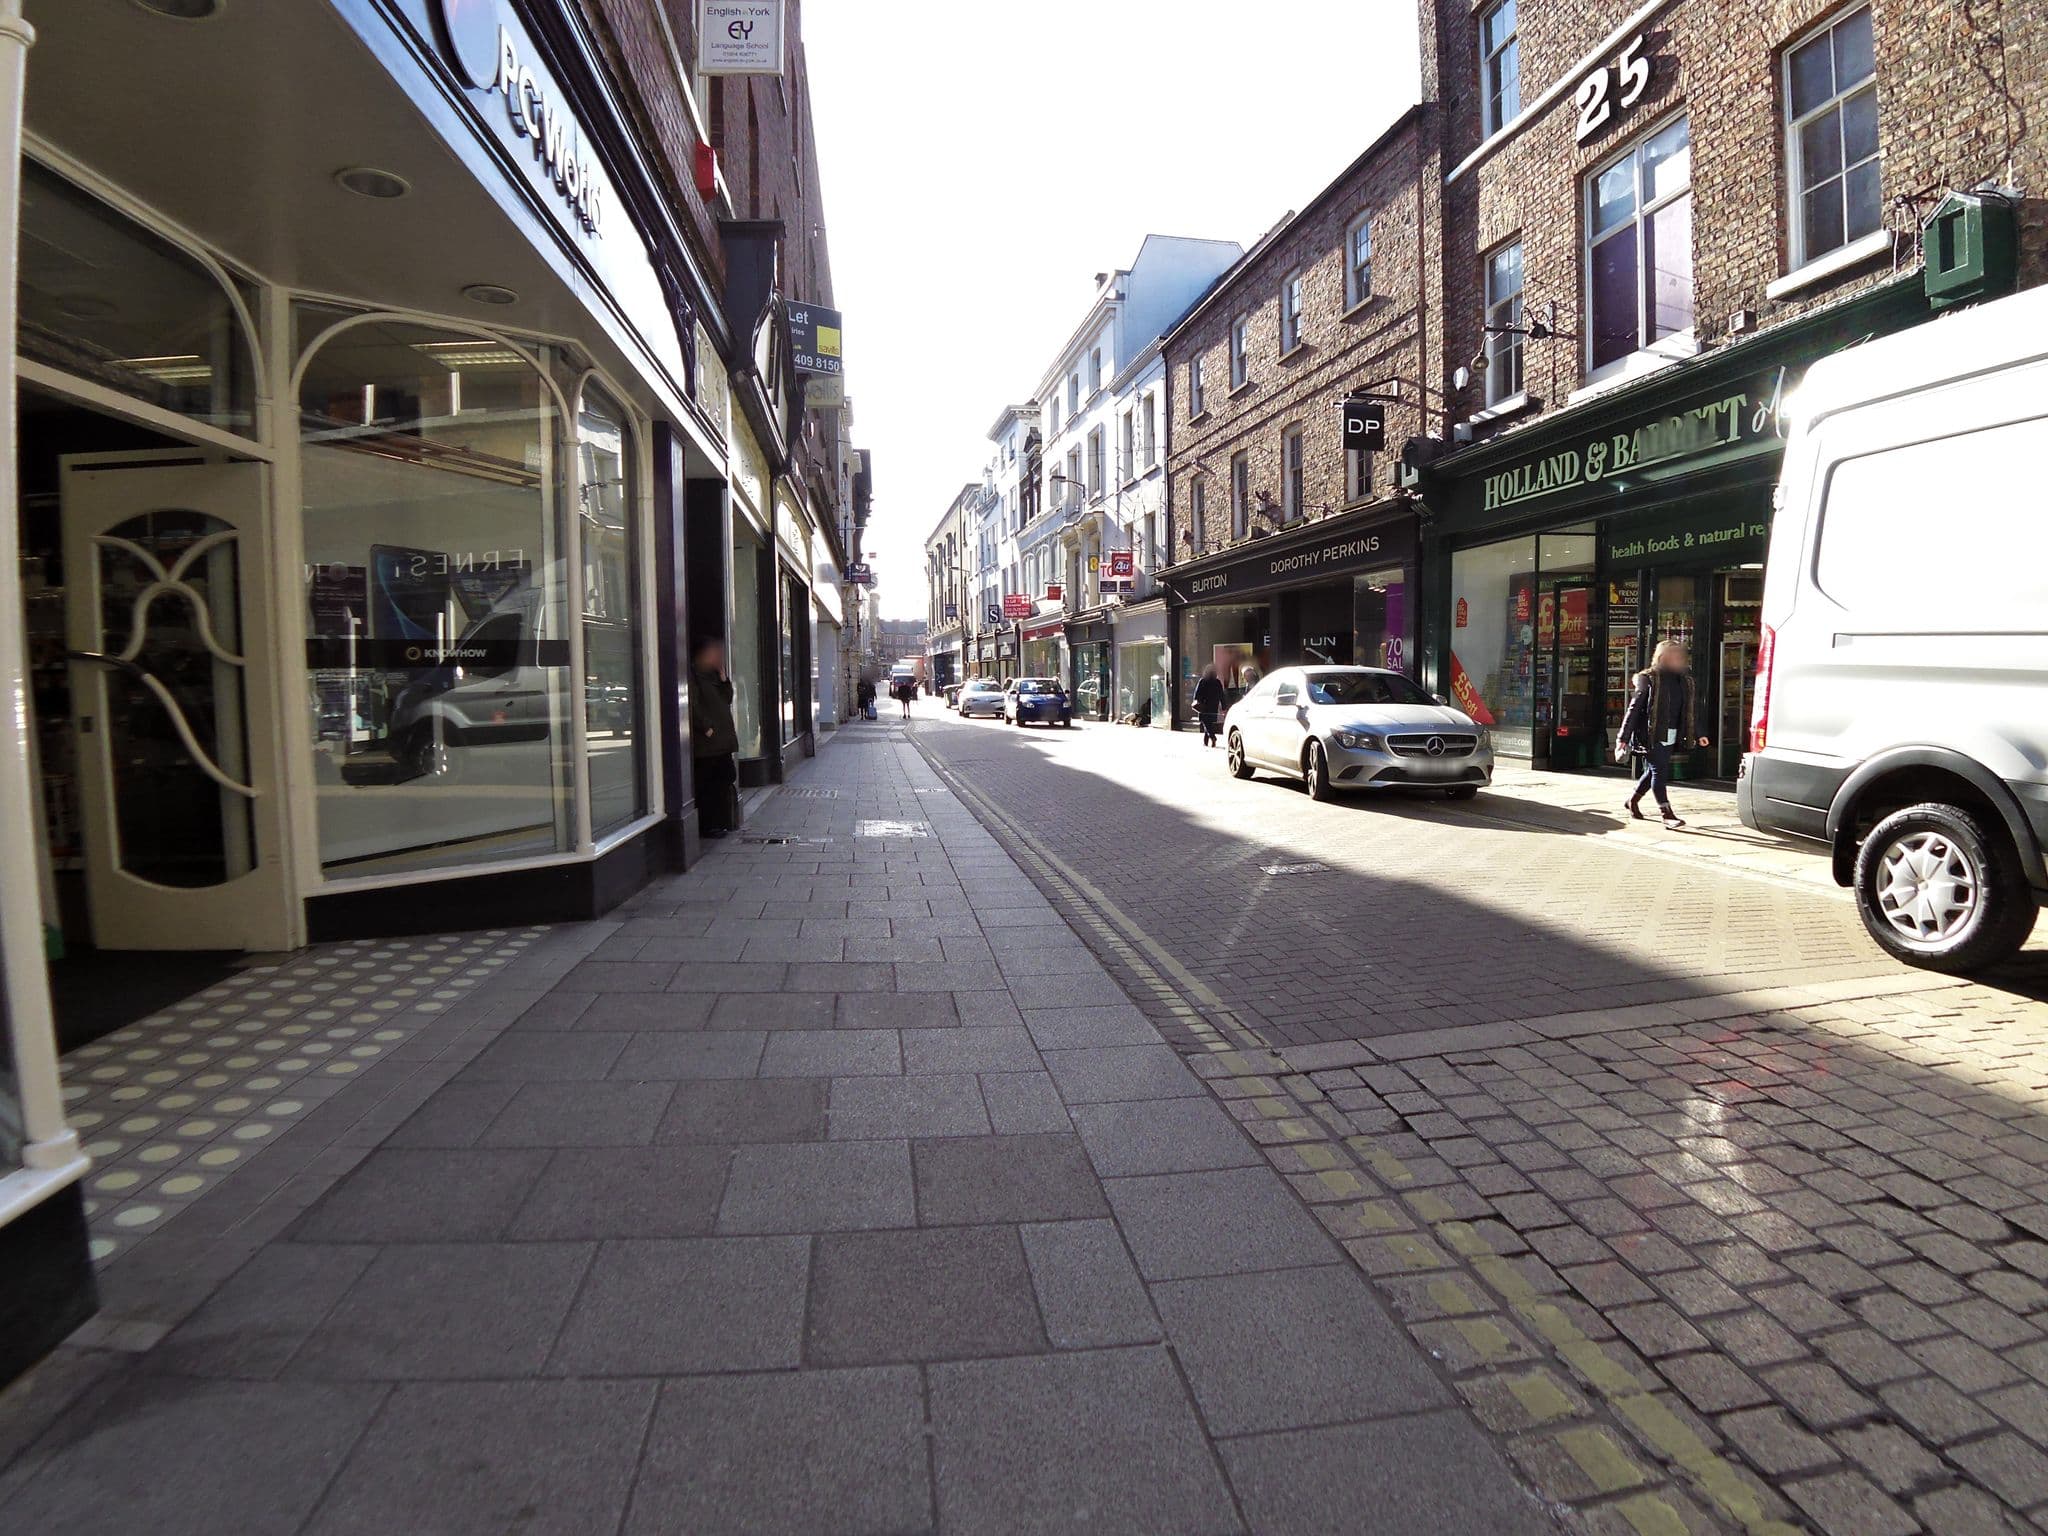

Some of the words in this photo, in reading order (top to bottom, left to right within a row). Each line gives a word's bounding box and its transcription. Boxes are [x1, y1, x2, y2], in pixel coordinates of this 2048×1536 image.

[706, 7, 741, 17] English
[748, 8, 770, 16] York
[1575, 33, 1649, 142] 25
[788, 307, 809, 324] Let
[816, 358, 840, 372] 8150
[1348, 418, 1380, 434] DP
[1483, 450, 1580, 511] HOLLAND
[1584, 442, 1608, 482] &
[1612, 541, 1645, 559] health
[1648, 535, 1680, 553] foods
[1684, 532, 1695, 547] &
[1700, 522, 1745, 545] natural
[1750, 523, 1765, 536] re
[1270, 550, 1320, 574] DOROTHY
[1323, 536, 1380, 562] PERKINS
[1192, 573, 1227, 594] BURTON
[1568, 616, 1583, 631] off
[424, 648, 487, 658] KNOWHOW
[1387, 657, 1404, 669] SAL
[1455, 671, 1473, 700] £5
